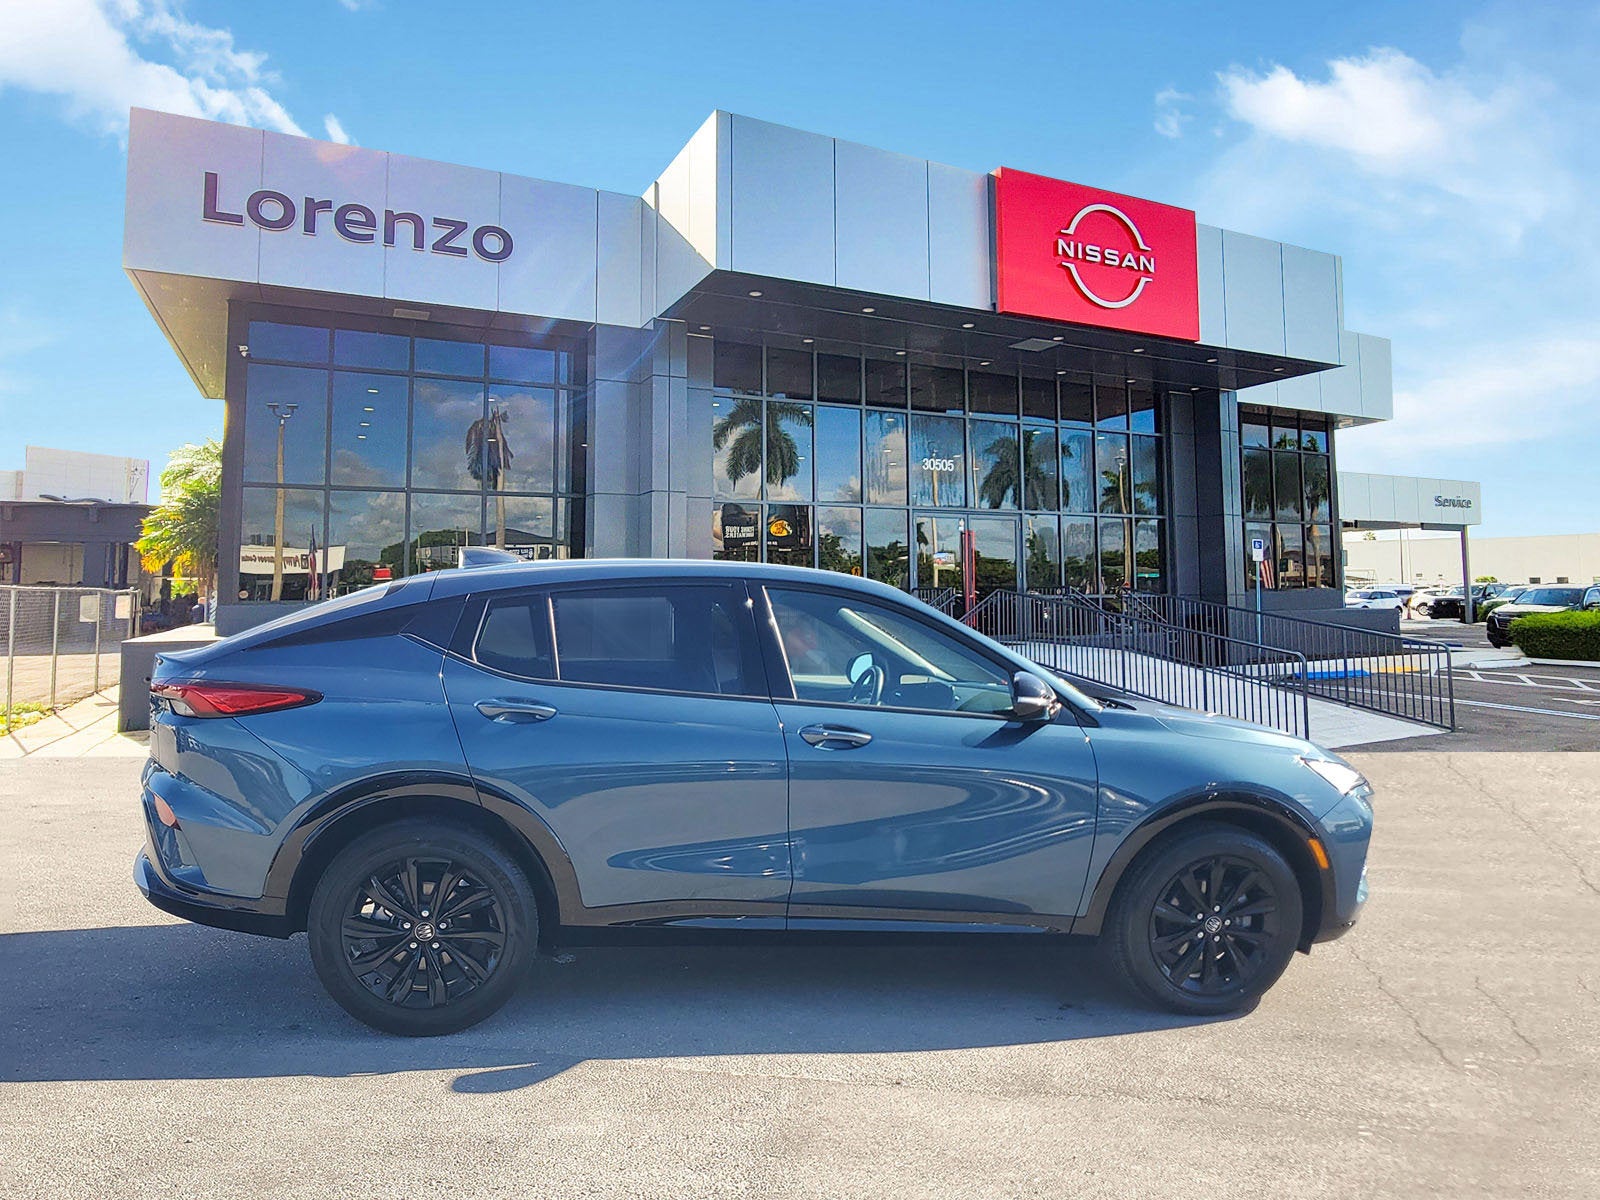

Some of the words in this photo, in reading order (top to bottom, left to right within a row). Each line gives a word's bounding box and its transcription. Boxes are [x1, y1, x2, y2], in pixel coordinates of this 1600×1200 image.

[203, 171, 515, 263] Lorenzo
[1057, 238, 1155, 273] NISSAN
[922, 458, 954, 472] 30505
[1434, 495, 1472, 509] Service
